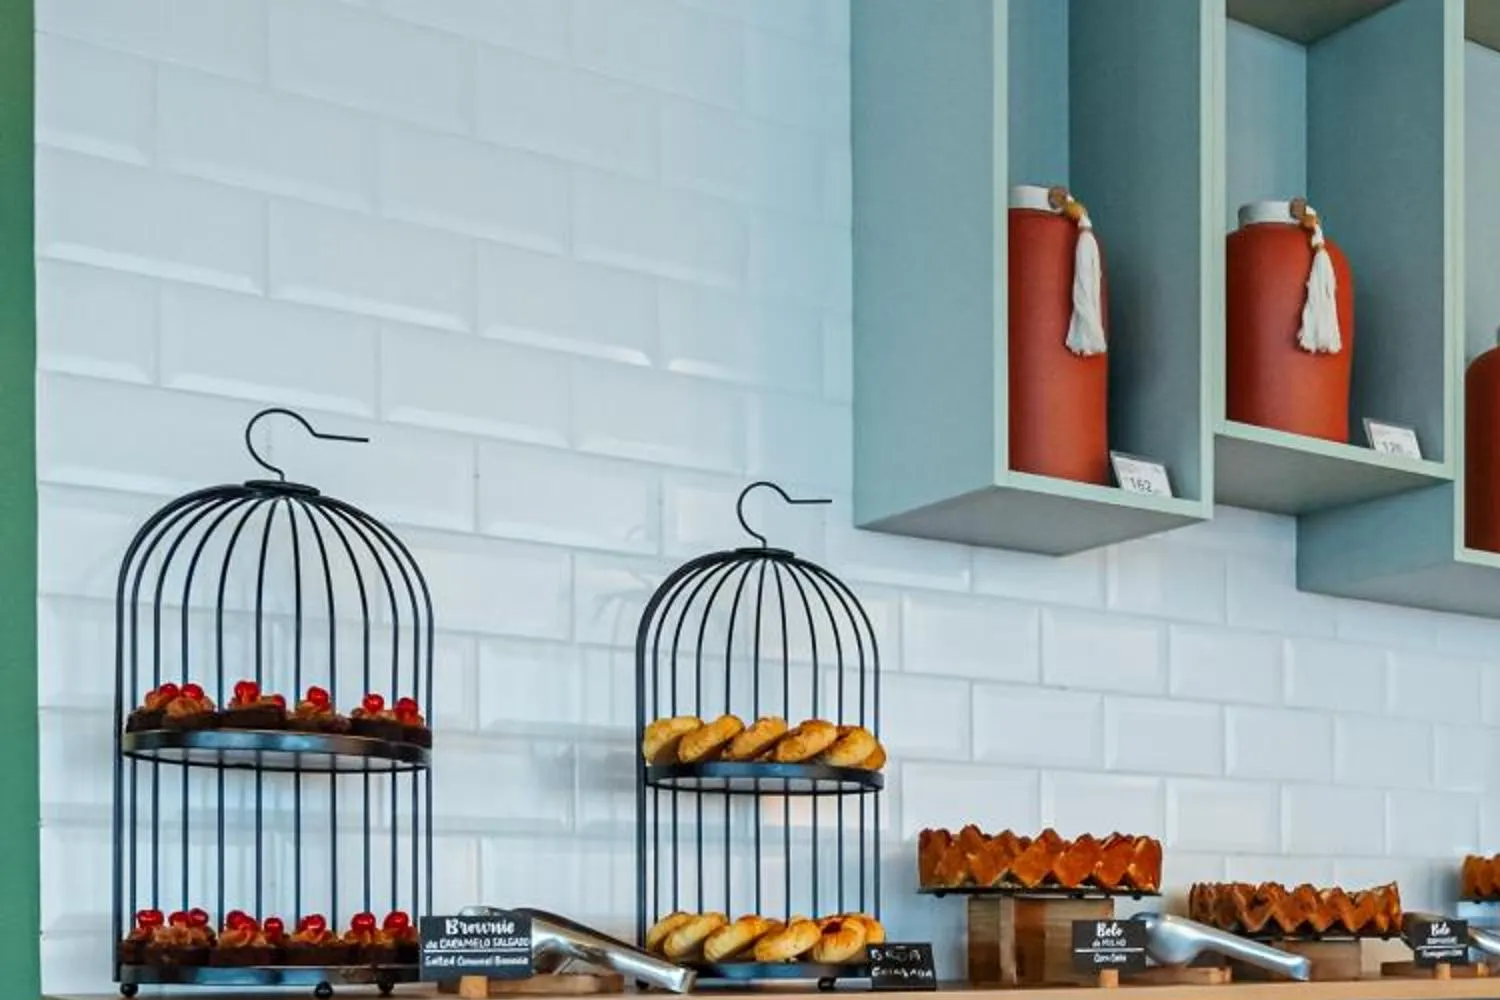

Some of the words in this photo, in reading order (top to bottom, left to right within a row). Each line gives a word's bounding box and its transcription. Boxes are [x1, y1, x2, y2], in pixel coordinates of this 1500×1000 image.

[445, 918, 516, 935] Brownie
[1096, 921, 1123, 938] Bolo
[440, 938, 491, 949] CARAMELO
